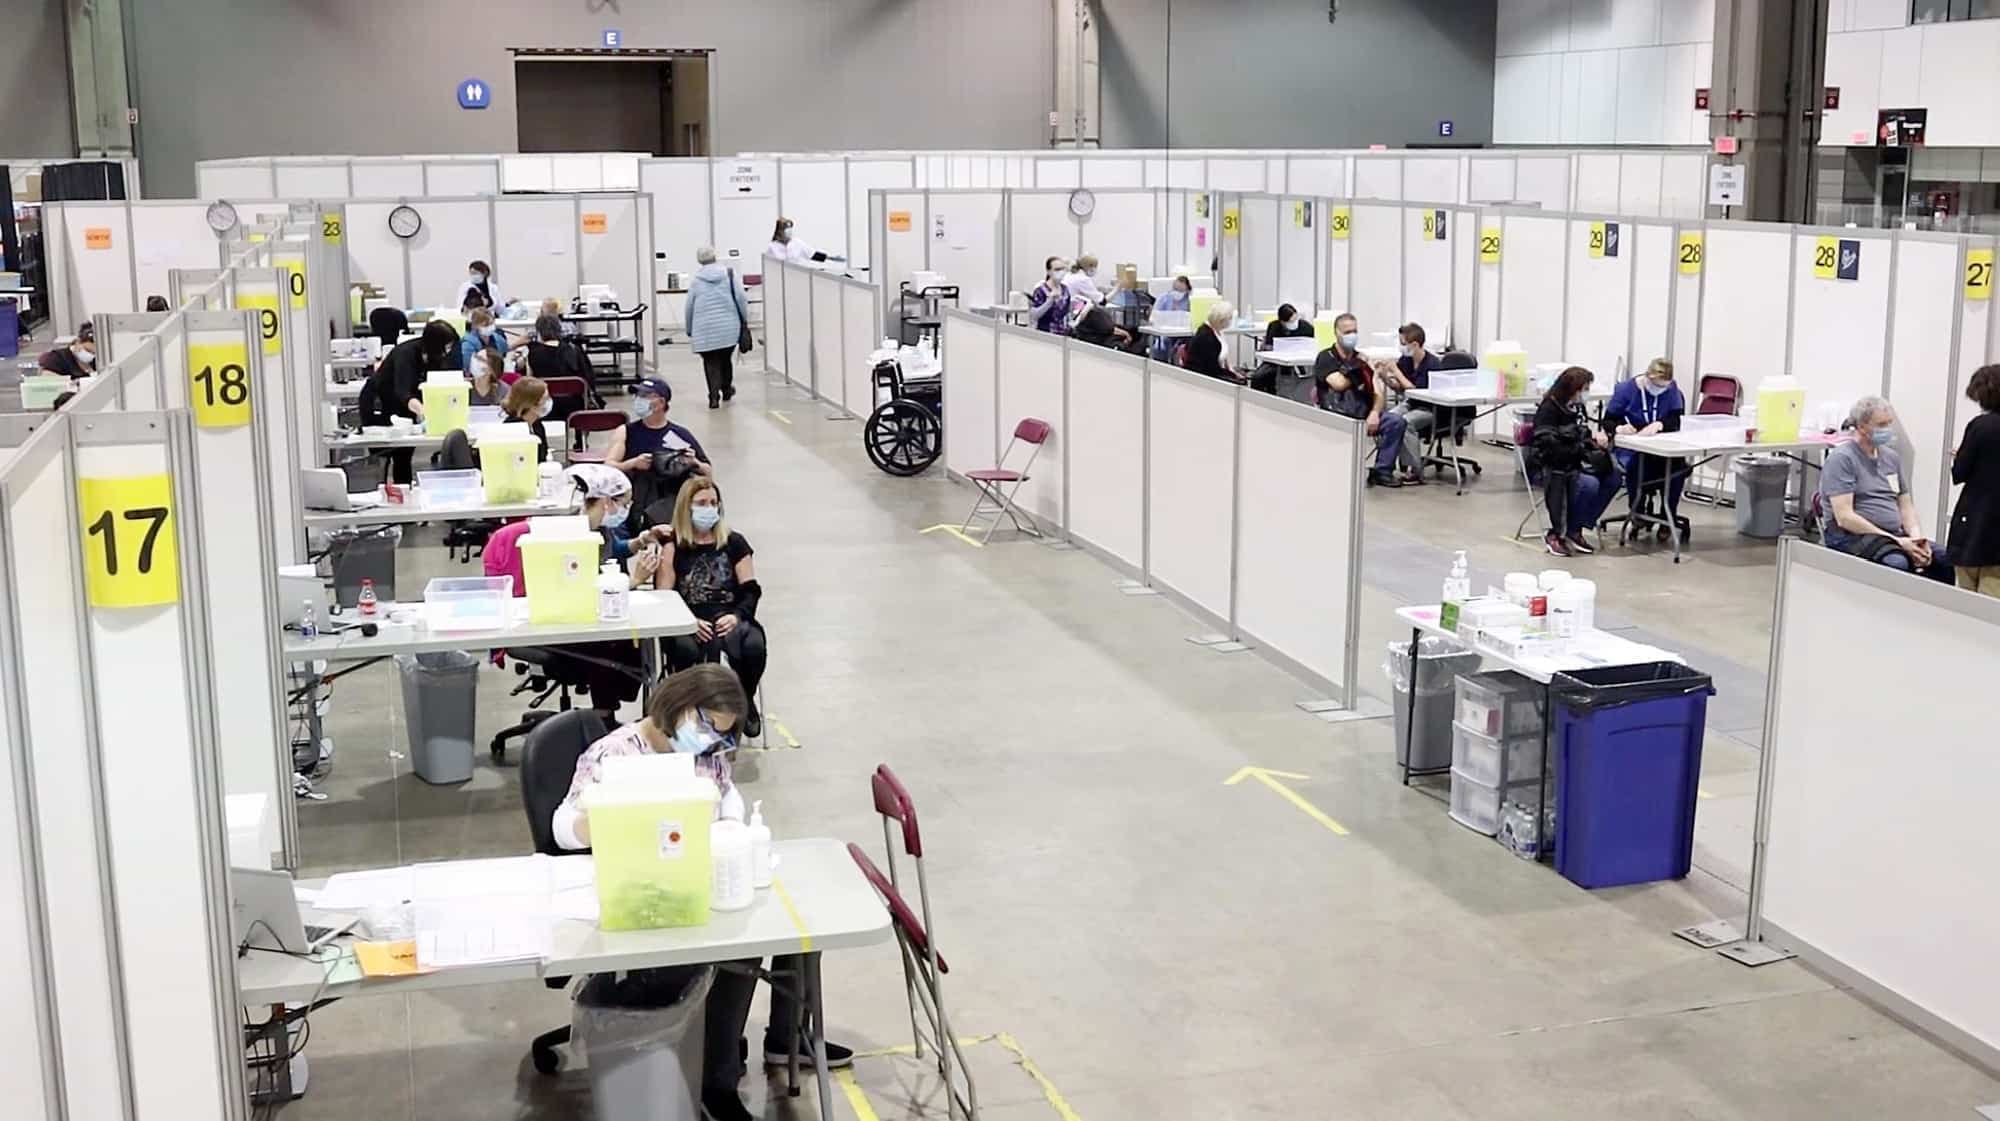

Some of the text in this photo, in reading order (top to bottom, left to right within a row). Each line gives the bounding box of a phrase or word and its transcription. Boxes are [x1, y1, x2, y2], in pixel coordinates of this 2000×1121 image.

[606, 32, 617, 45] E
[1442, 123, 1451, 135] E
[323, 221, 341, 237] 23
[1223, 215, 1238, 230] 31
[1332, 215, 1349, 231] 30
[1481, 236, 1500, 254] 29
[1590, 230, 1604, 249] 29
[1680, 243, 1702, 264] 28
[1815, 245, 1836, 268] 28
[290, 272, 305, 296] 0
[1967, 263, 1993, 287] 27
[261, 309, 279, 339] 9
[194, 364, 248, 407] 18
[88, 506, 169, 576] 17
